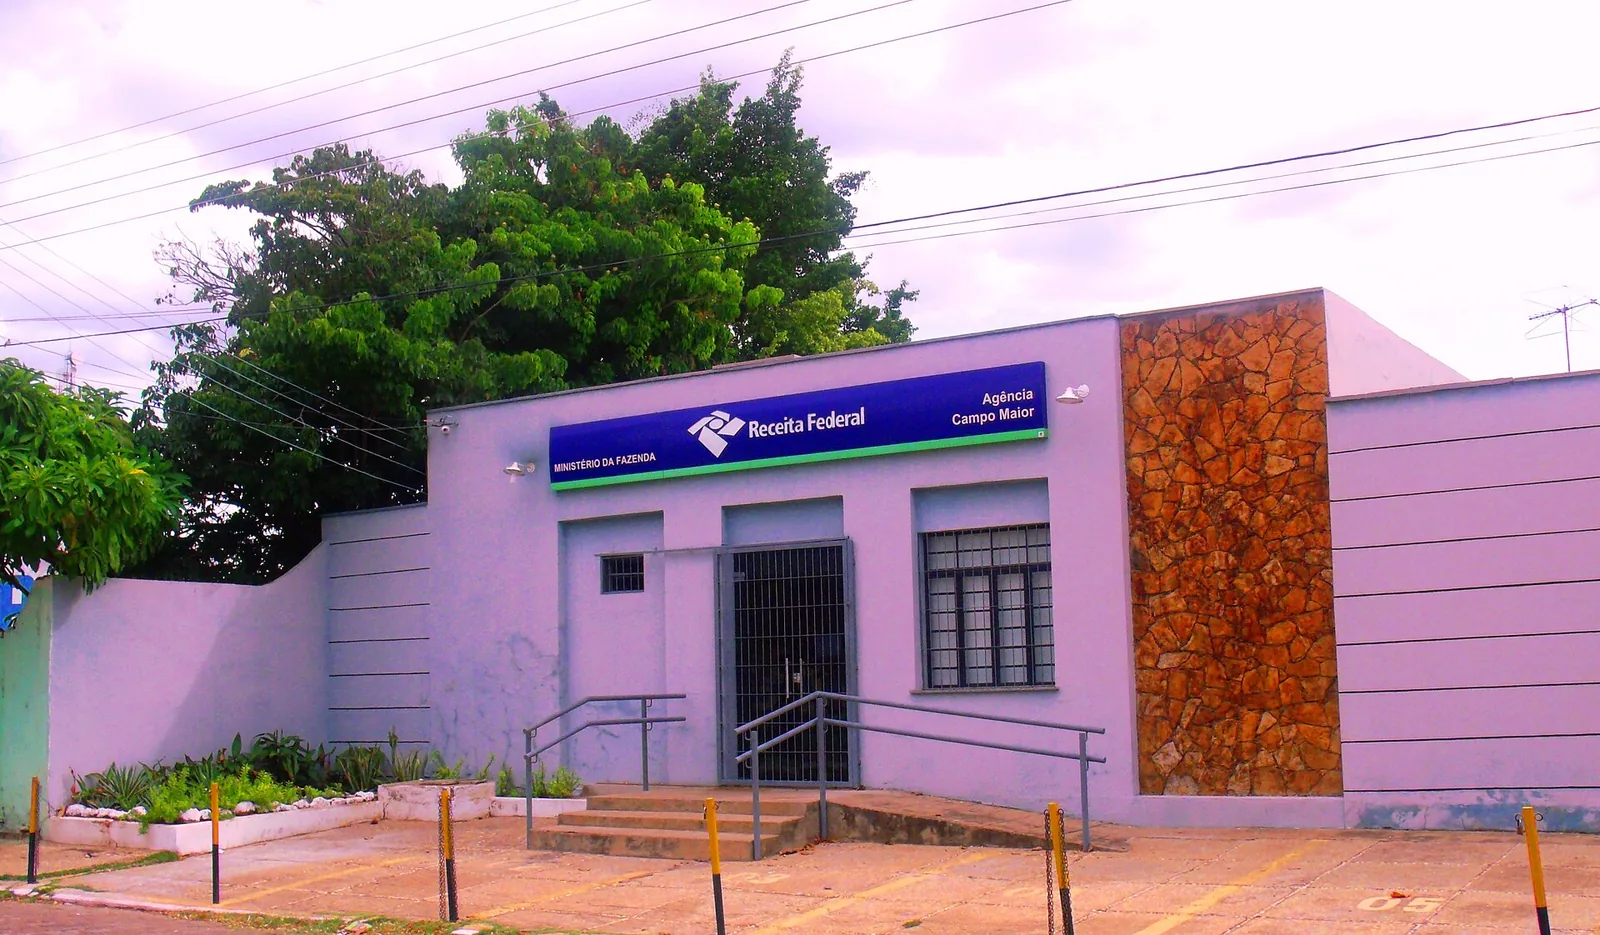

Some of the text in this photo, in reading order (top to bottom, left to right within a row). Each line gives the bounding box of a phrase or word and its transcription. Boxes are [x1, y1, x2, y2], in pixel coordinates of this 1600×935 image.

[982, 388, 1034, 406] Agência
[748, 406, 865, 438] Receita Federal
[952, 406, 1035, 426] Campo Maior
[554, 452, 657, 473] MINISTÉRIO DA FAZENDA
[1356, 896, 1446, 913] 05
